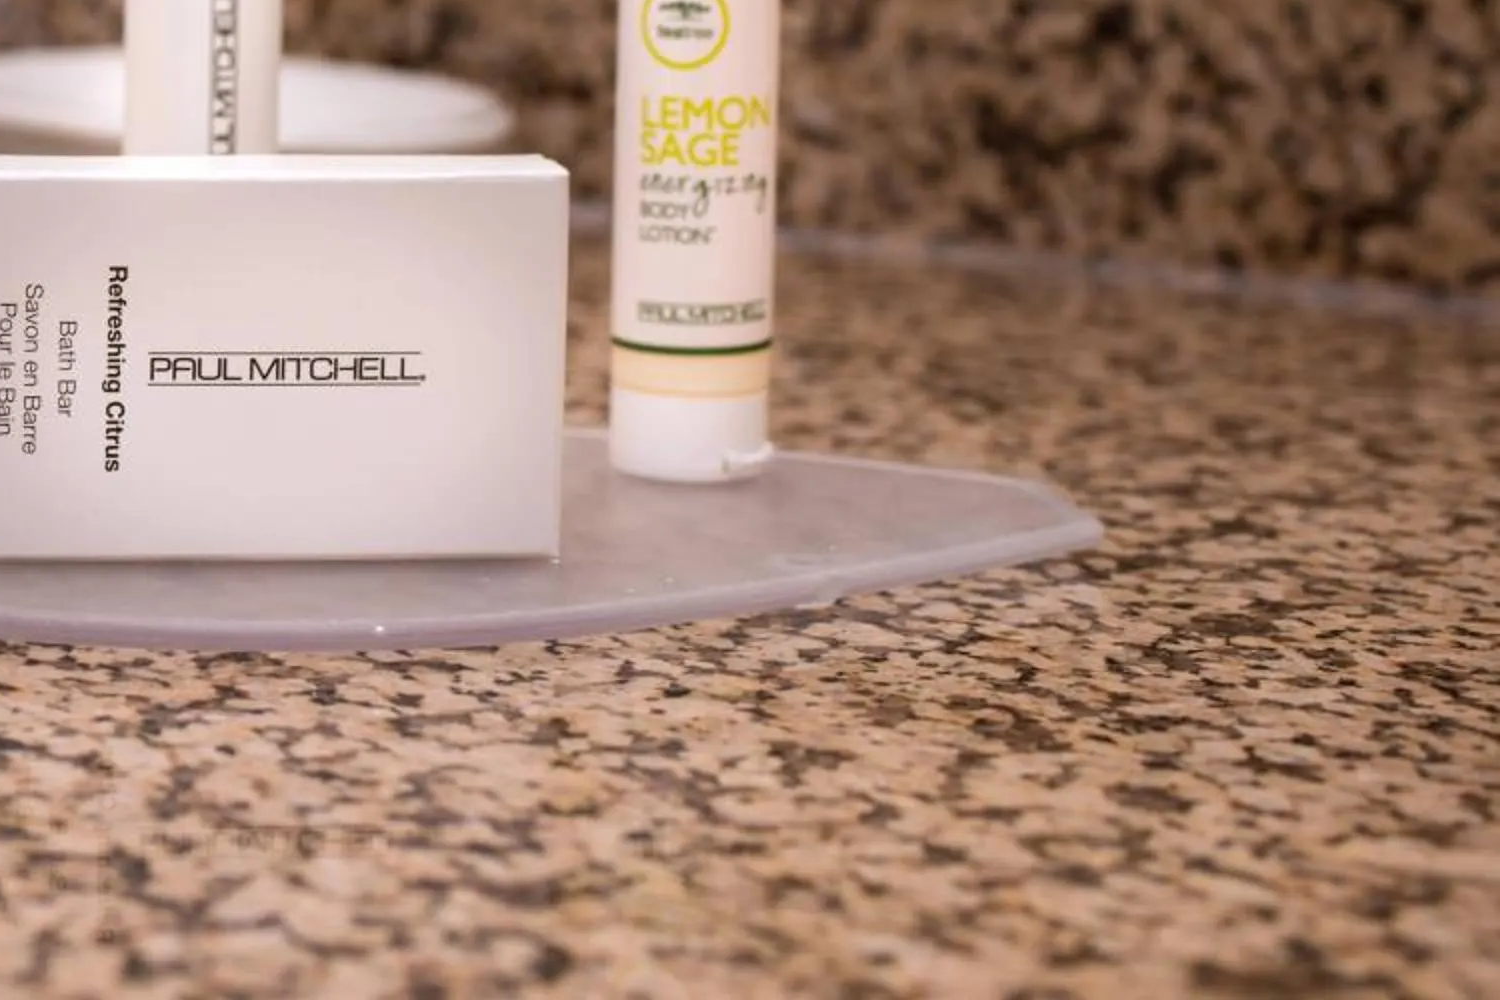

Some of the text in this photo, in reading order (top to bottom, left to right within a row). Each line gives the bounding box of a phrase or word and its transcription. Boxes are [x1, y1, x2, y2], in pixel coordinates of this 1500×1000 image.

[642, 96, 770, 130] LEMON
[641, 131, 739, 166] SAGE
[640, 201, 690, 221] BODY
[22, 284, 44, 455] Savon en Barre
[57, 321, 78, 418] Bath Bar
[102, 266, 128, 472] Refreshing Citrus
[150, 357, 242, 380] PAUL
